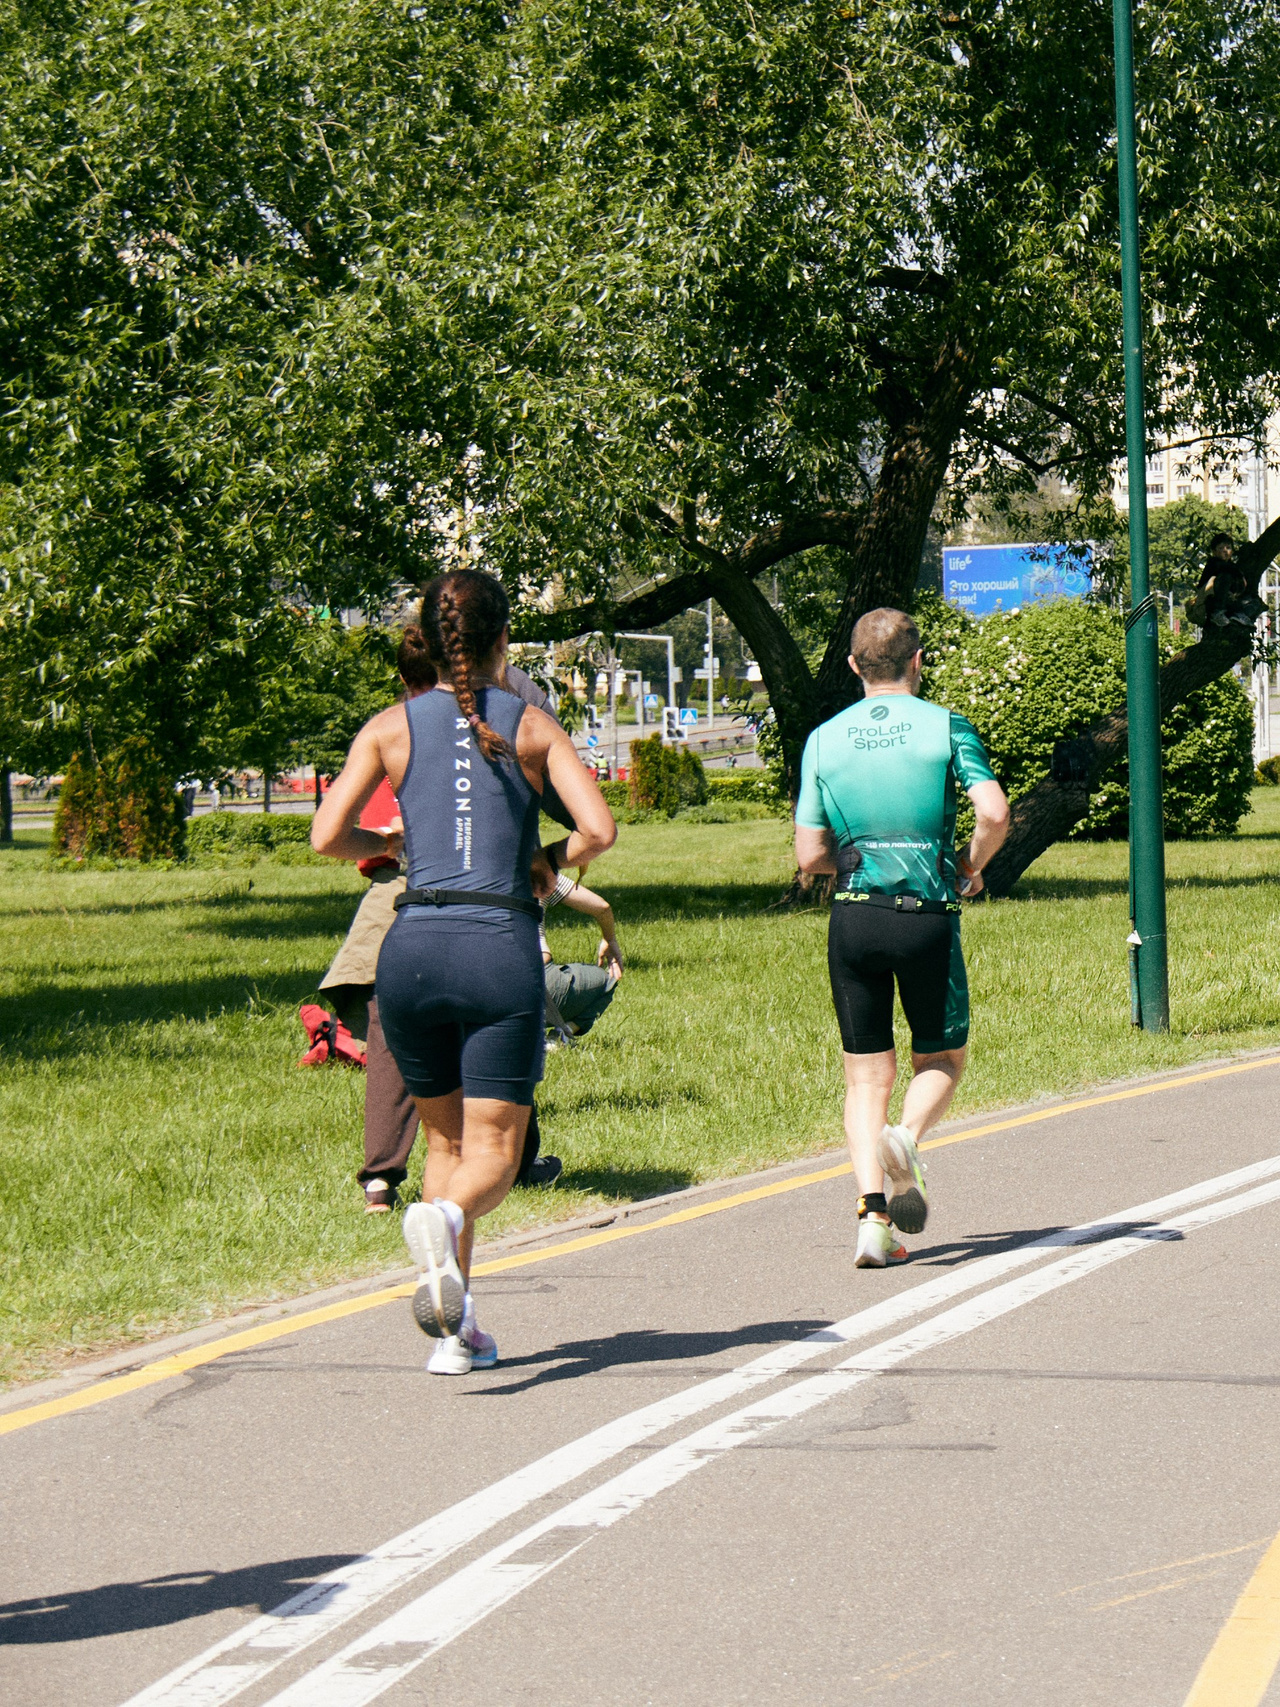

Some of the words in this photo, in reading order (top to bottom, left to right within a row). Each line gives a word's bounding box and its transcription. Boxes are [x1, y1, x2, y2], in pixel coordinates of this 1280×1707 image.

[949, 557, 967, 571] life
[949, 580, 969, 592] Это
[971, 577, 1019, 593] хороший
[847, 721, 912, 738] ProLab
[854, 734, 907, 751] Sport
[455, 717, 471, 811] RYZON
[455, 817, 463, 851] APPAREL
[463, 817, 472, 870] PERFORMANCE
